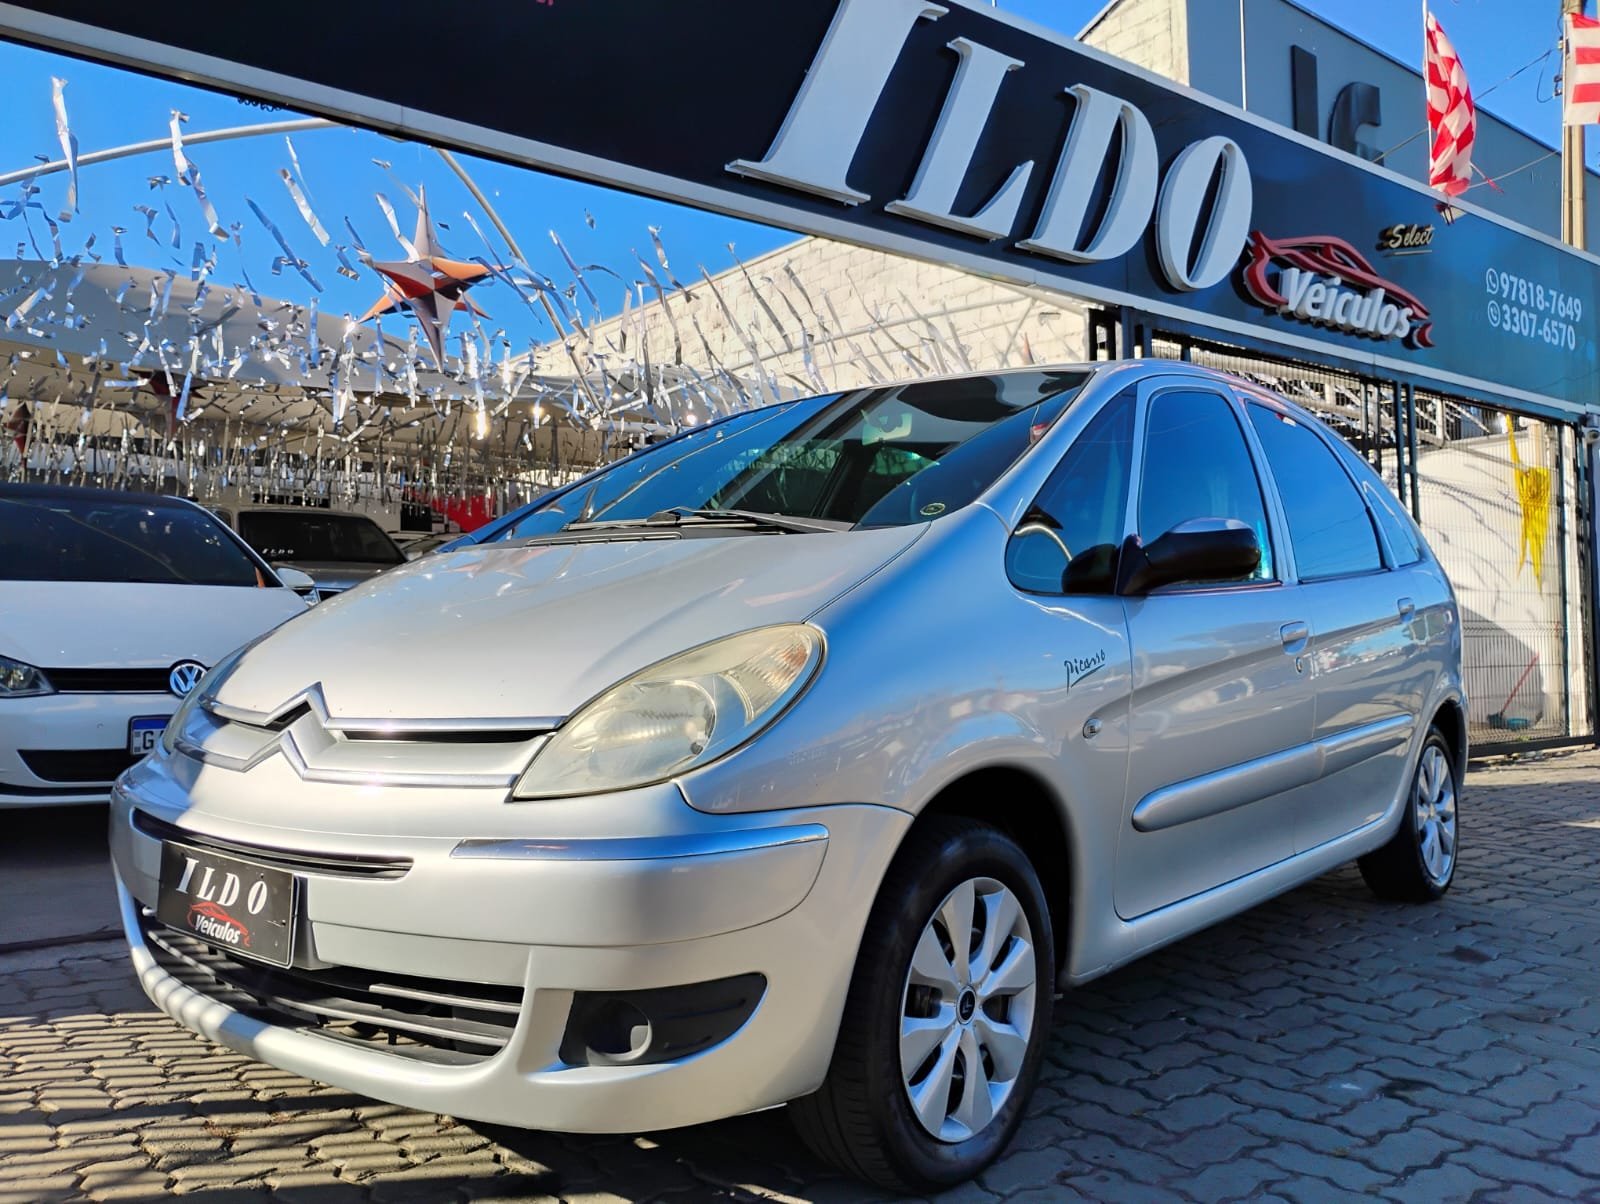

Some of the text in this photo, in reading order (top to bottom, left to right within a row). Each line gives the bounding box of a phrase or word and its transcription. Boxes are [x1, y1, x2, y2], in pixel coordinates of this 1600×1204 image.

[725, 0, 1253, 291] ILDO
[1389, 223, 1435, 249] Select
[1500, 271, 1582, 322] 97818-7649
[1502, 303, 1576, 351] 3307-6570
[176, 857, 268, 915] ILDO
